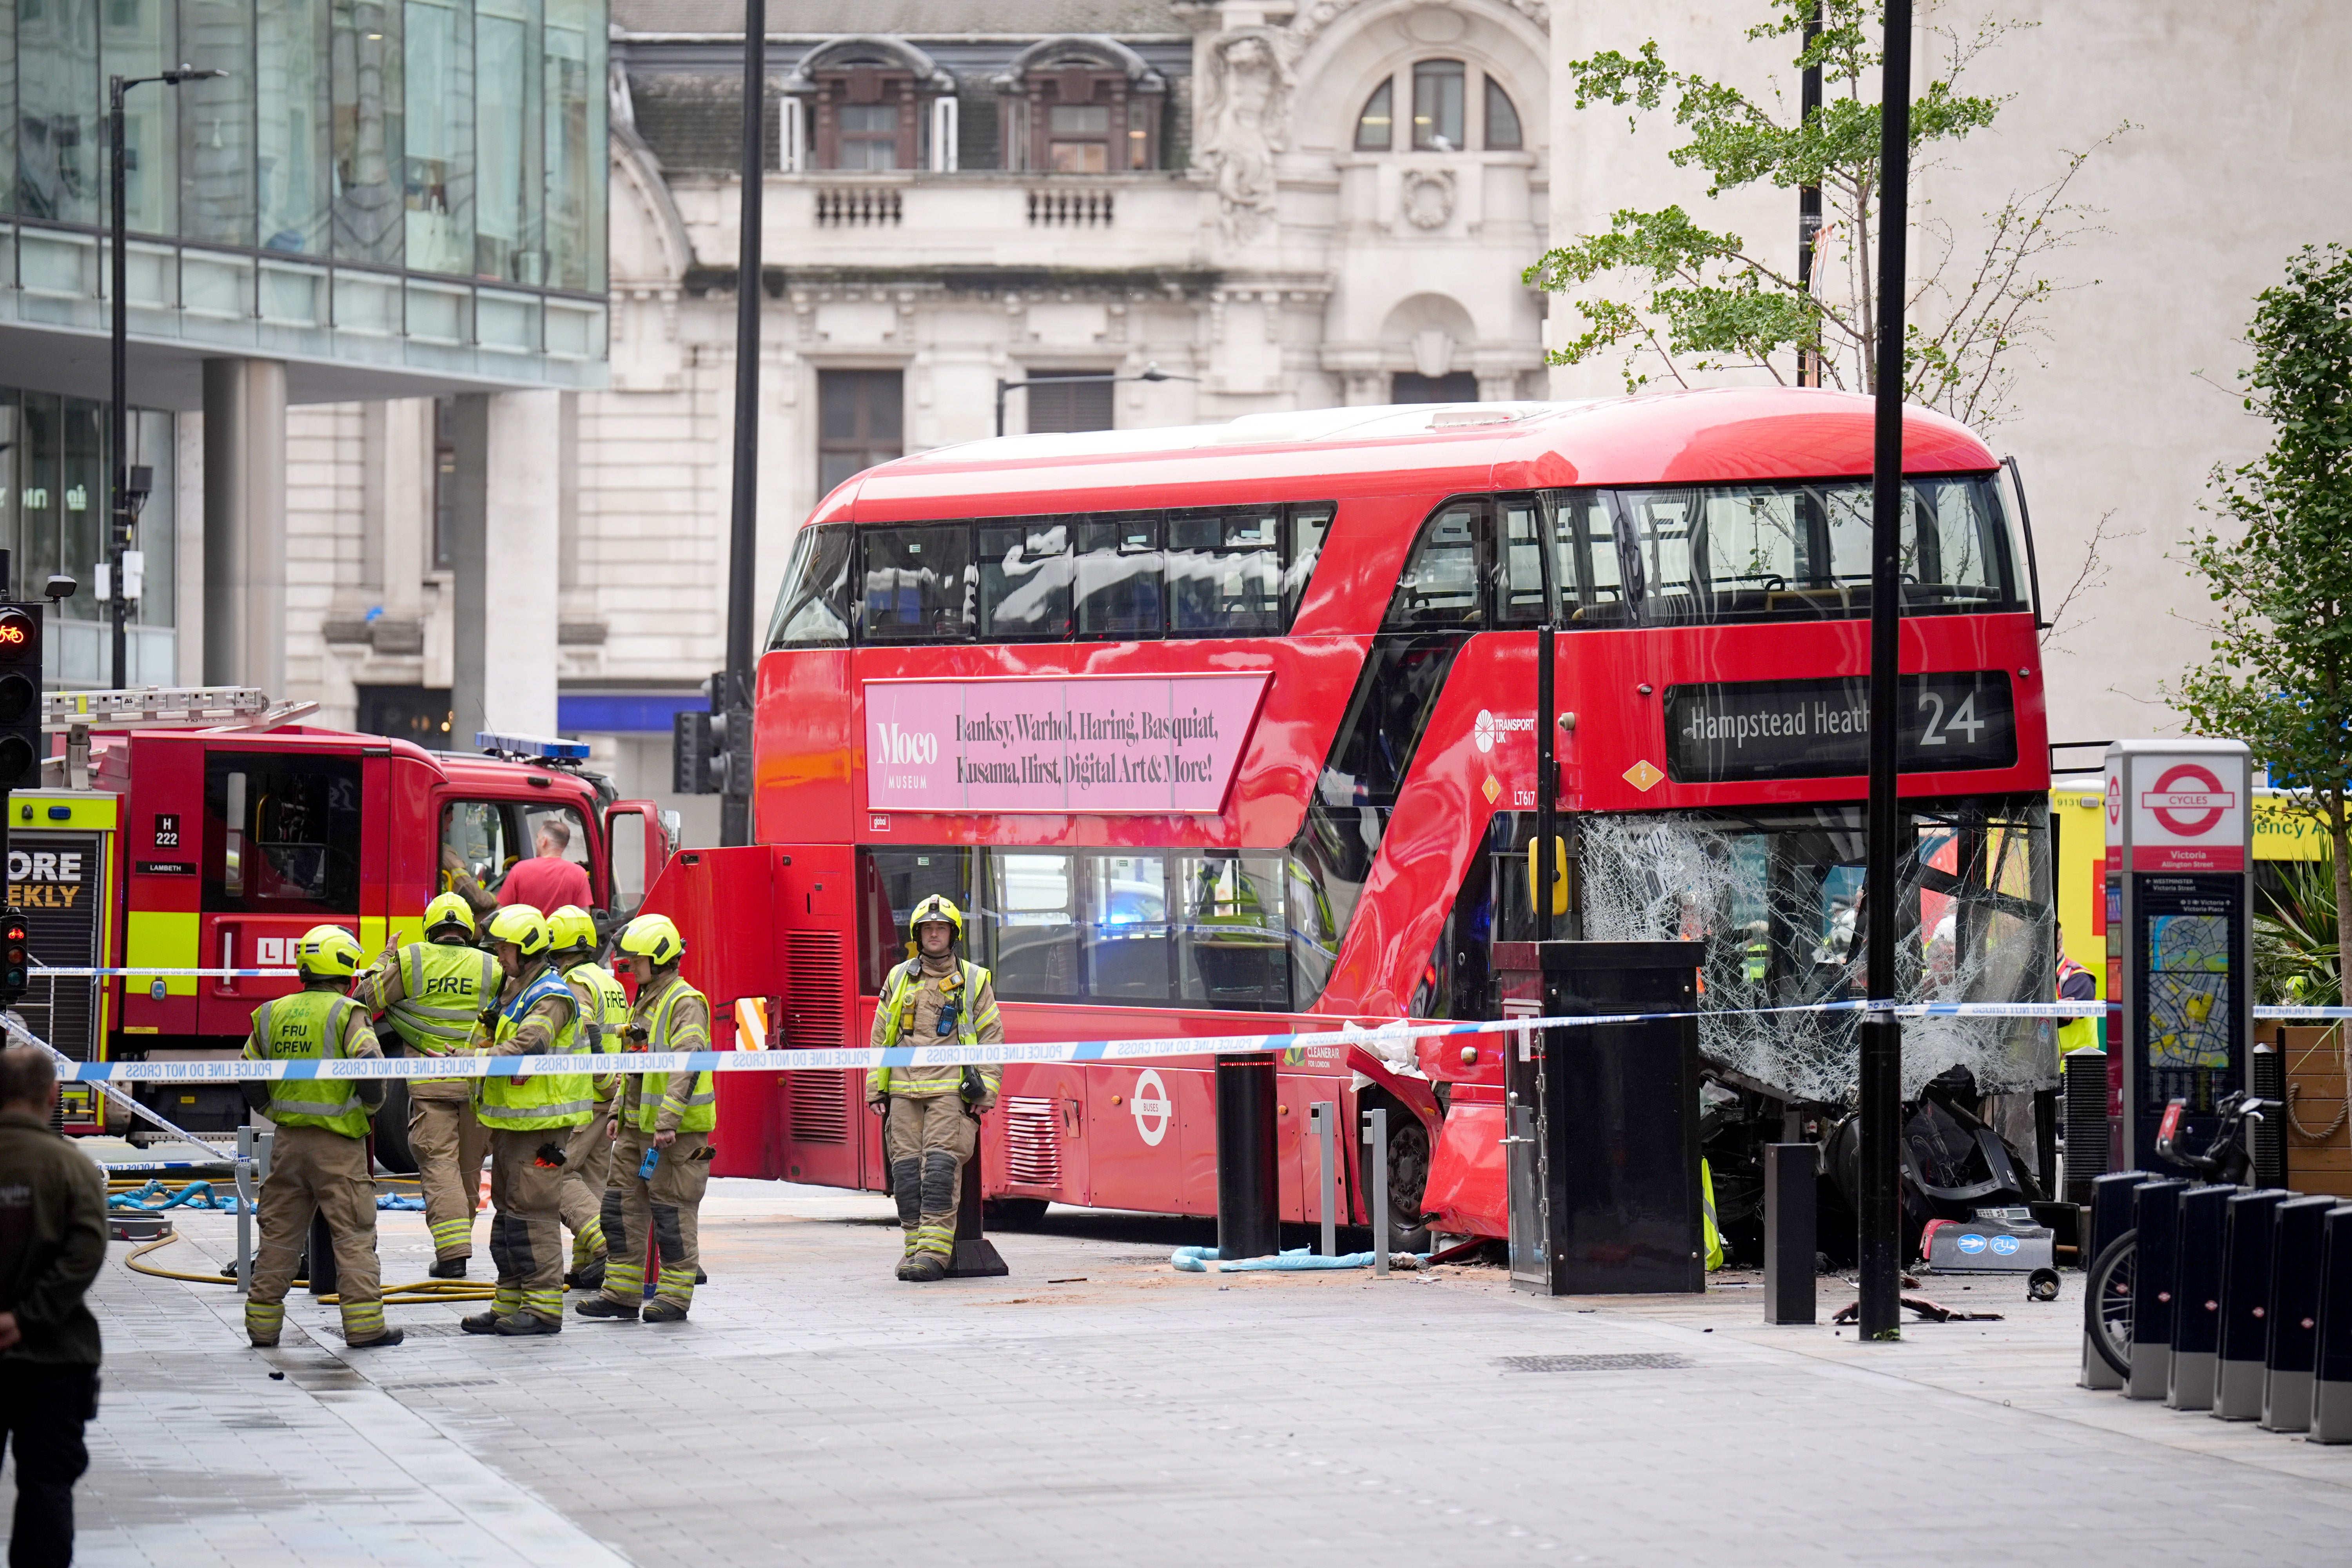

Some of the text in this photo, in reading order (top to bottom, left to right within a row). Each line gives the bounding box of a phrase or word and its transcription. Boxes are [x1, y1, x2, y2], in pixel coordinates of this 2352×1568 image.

[1691, 699, 1870, 748] Hampstead Heath
[1918, 691, 1985, 745] 24
[955, 707, 1218, 749] Banksy, Warhol, Haring, Basquiat,
[1494, 719, 1535, 731] TRANSPORT
[876, 722, 938, 764] Moco
[1496, 731, 1506, 743] UK
[956, 752, 1212, 790] Kusama, Hirst, Digital Art & More!
[888, 775, 927, 789] MUSEUM
[1514, 791, 1535, 806] LT617
[2169, 796, 2208, 804] CYCLES
[163, 818, 171, 830] H
[873, 816, 886, 829] global
[156, 833, 178, 845] 222
[2170, 851, 2207, 859] Victoria
[8, 851, 82, 881] ORE
[8, 885, 80, 907] EKLY
[425, 976, 473, 995] FIRE
[604, 991, 626, 1008] FIRE
[282, 1025, 307, 1037] FRU
[275, 1041, 312, 1053] CREW
[1316, 1060, 1330, 1069] LONDON
[1143, 1103, 1158, 1112] BUSES
